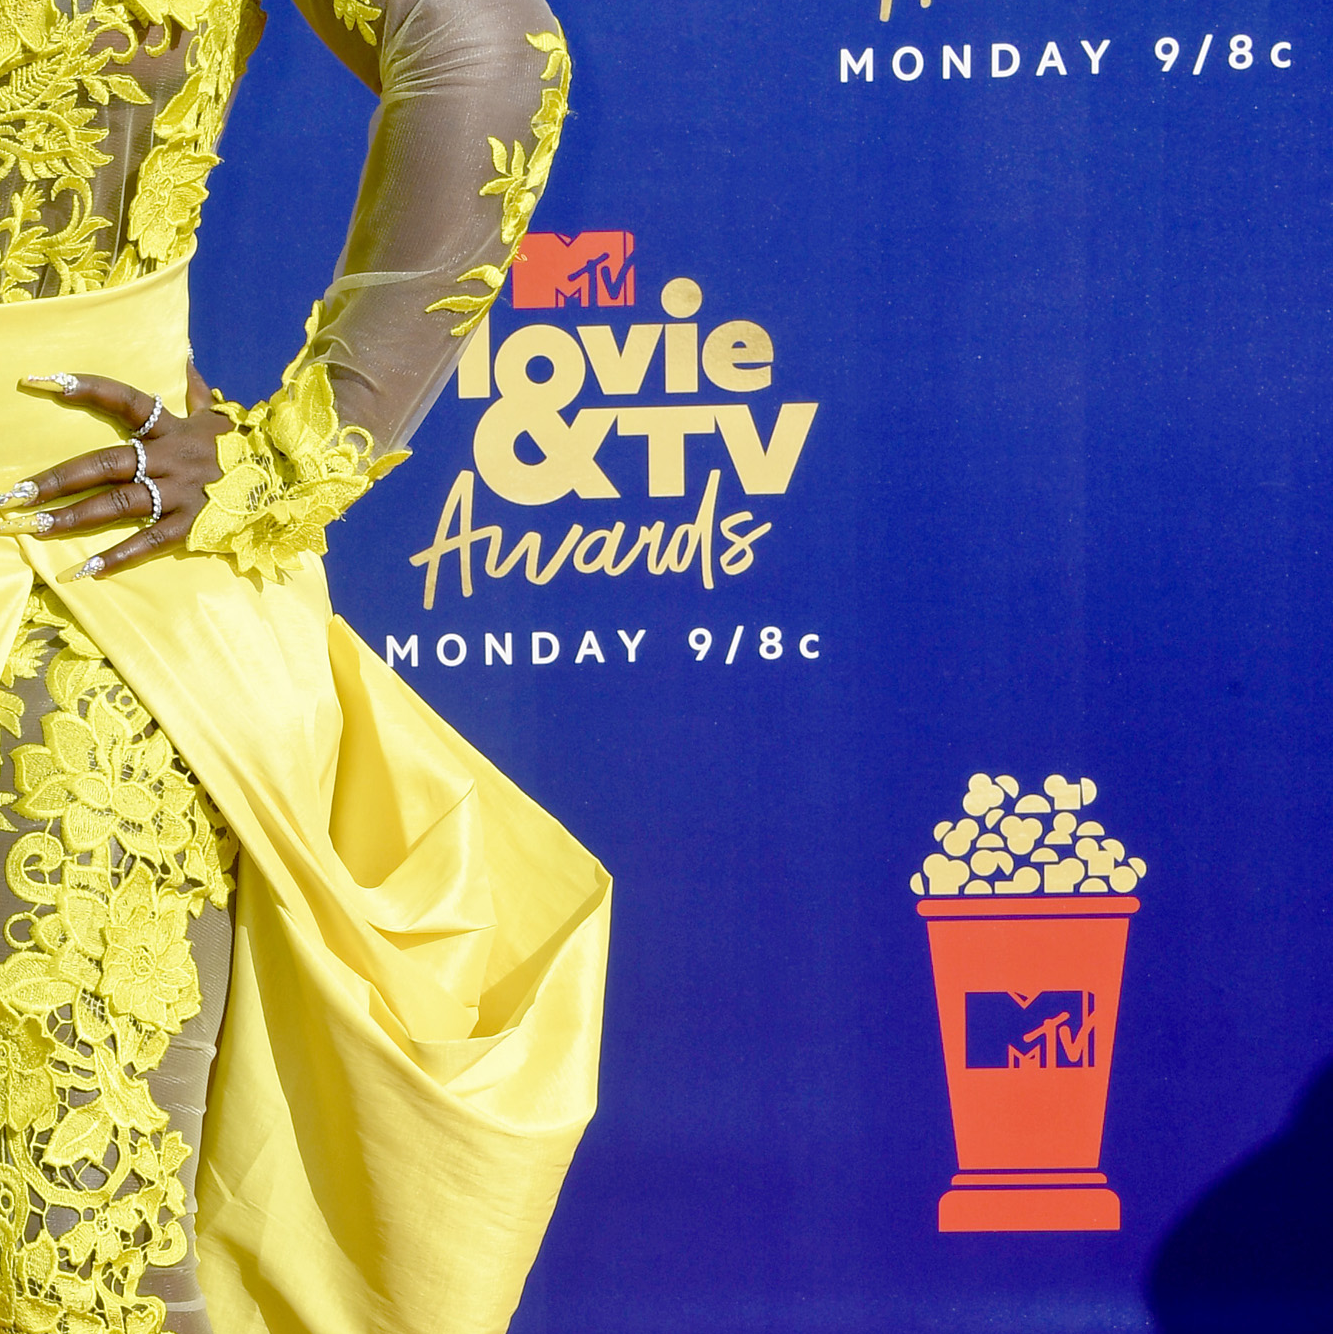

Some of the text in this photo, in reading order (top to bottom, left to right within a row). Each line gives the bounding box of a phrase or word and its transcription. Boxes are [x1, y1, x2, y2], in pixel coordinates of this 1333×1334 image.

[840, 34, 1293, 83] MONDAY 9/8c
[512, 231, 635, 309] MTV
[458, 277, 774, 399] ovie
[409, 469, 772, 610] Awards
[385, 625, 821, 668] MONDAY 9/8c
[966, 991, 1096, 1069] MTV
